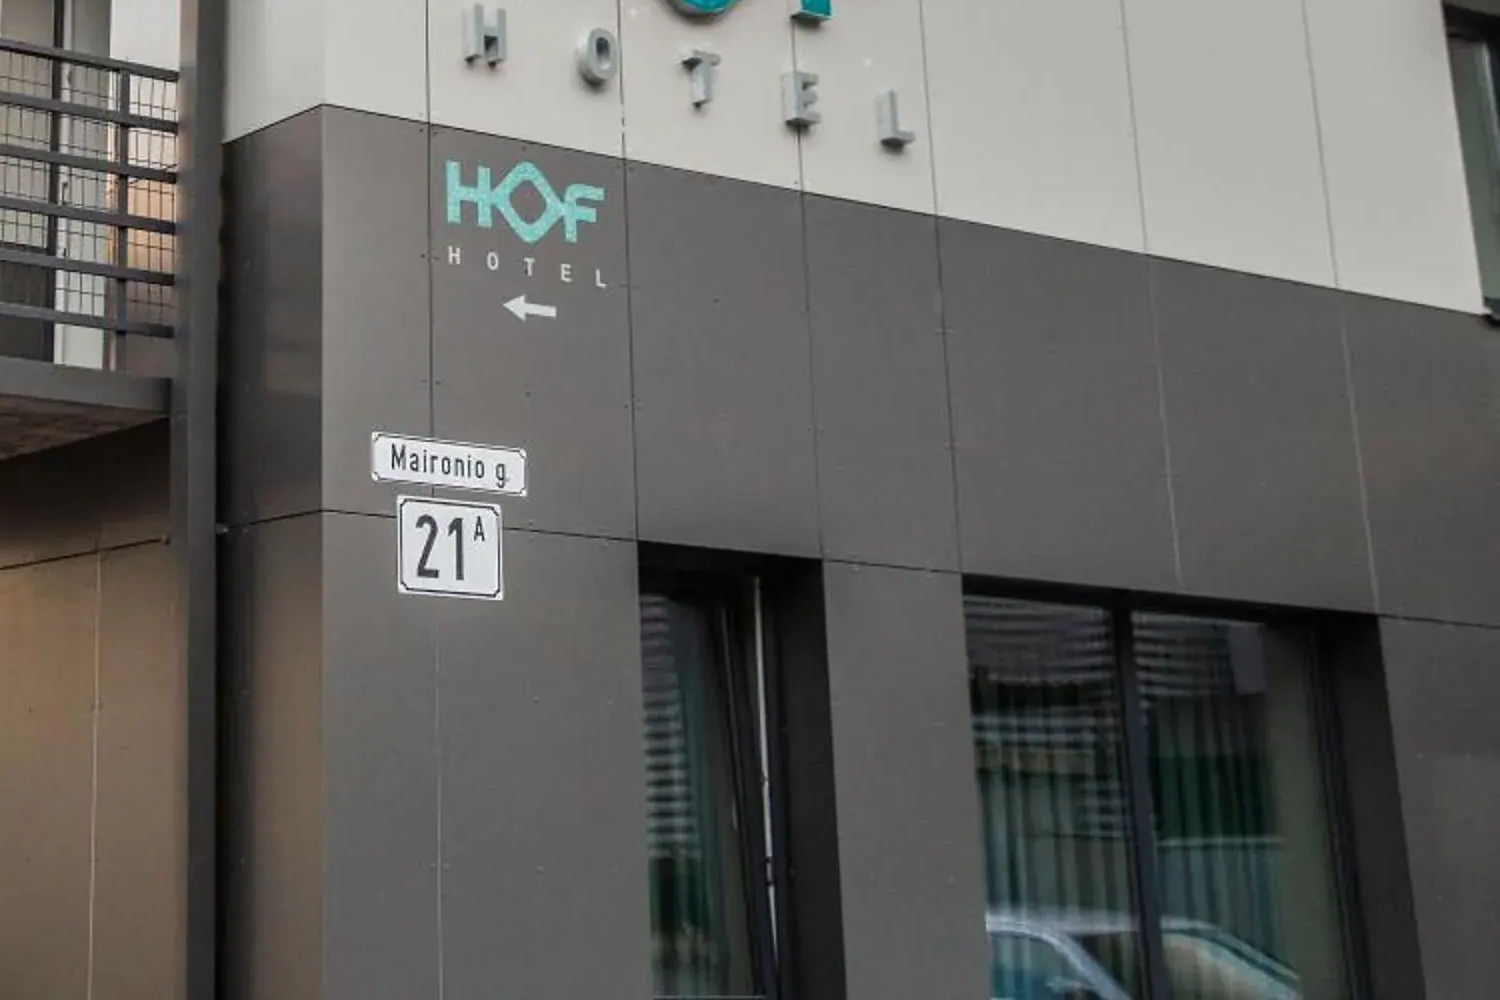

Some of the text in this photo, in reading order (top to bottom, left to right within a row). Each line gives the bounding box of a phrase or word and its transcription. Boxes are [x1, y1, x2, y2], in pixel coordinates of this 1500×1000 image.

[464, 3, 916, 147] HOTEL
[445, 160, 605, 243] HOF
[447, 247, 606, 289] HOTEL
[391, 443, 485, 479] Maironio
